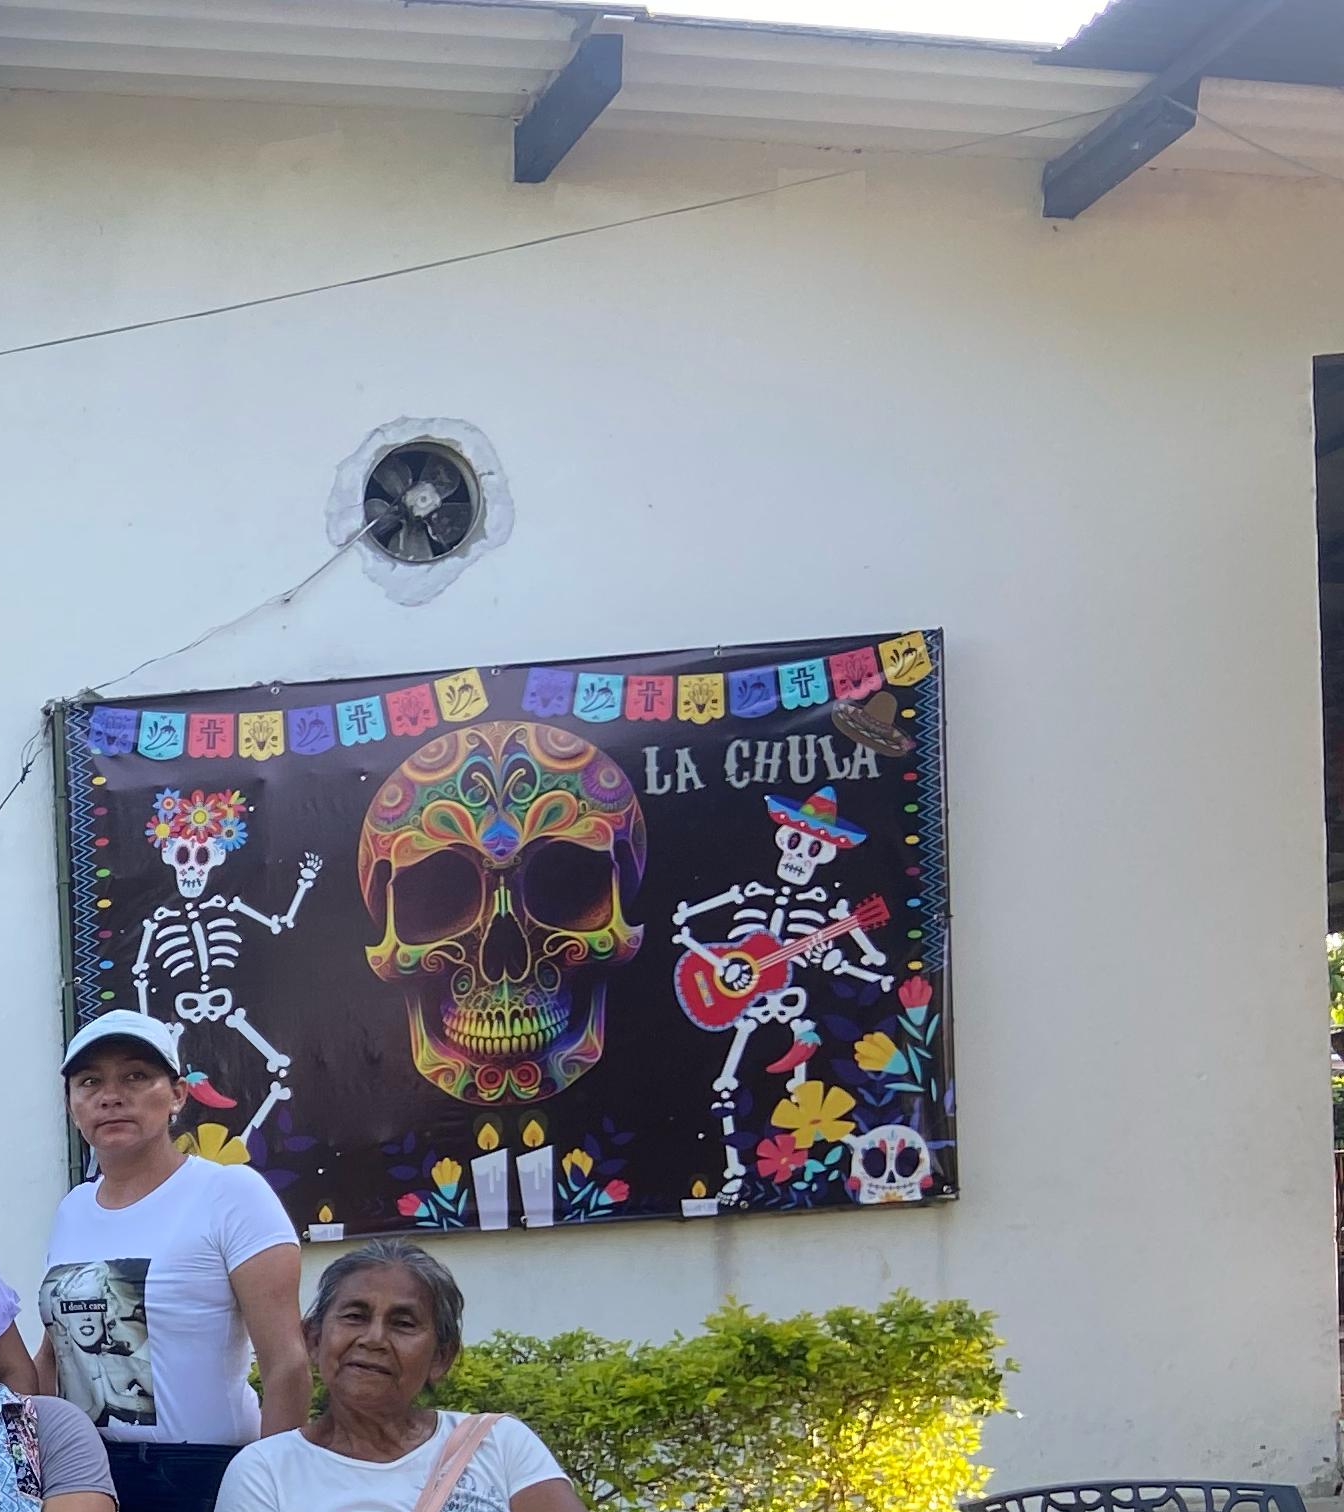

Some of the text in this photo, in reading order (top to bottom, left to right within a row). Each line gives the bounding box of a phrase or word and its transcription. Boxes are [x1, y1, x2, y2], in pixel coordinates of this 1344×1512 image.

[642, 734, 881, 795] LA CHULA
[68, 1301, 87, 1311] don't
[89, 1303, 105, 1311] care
